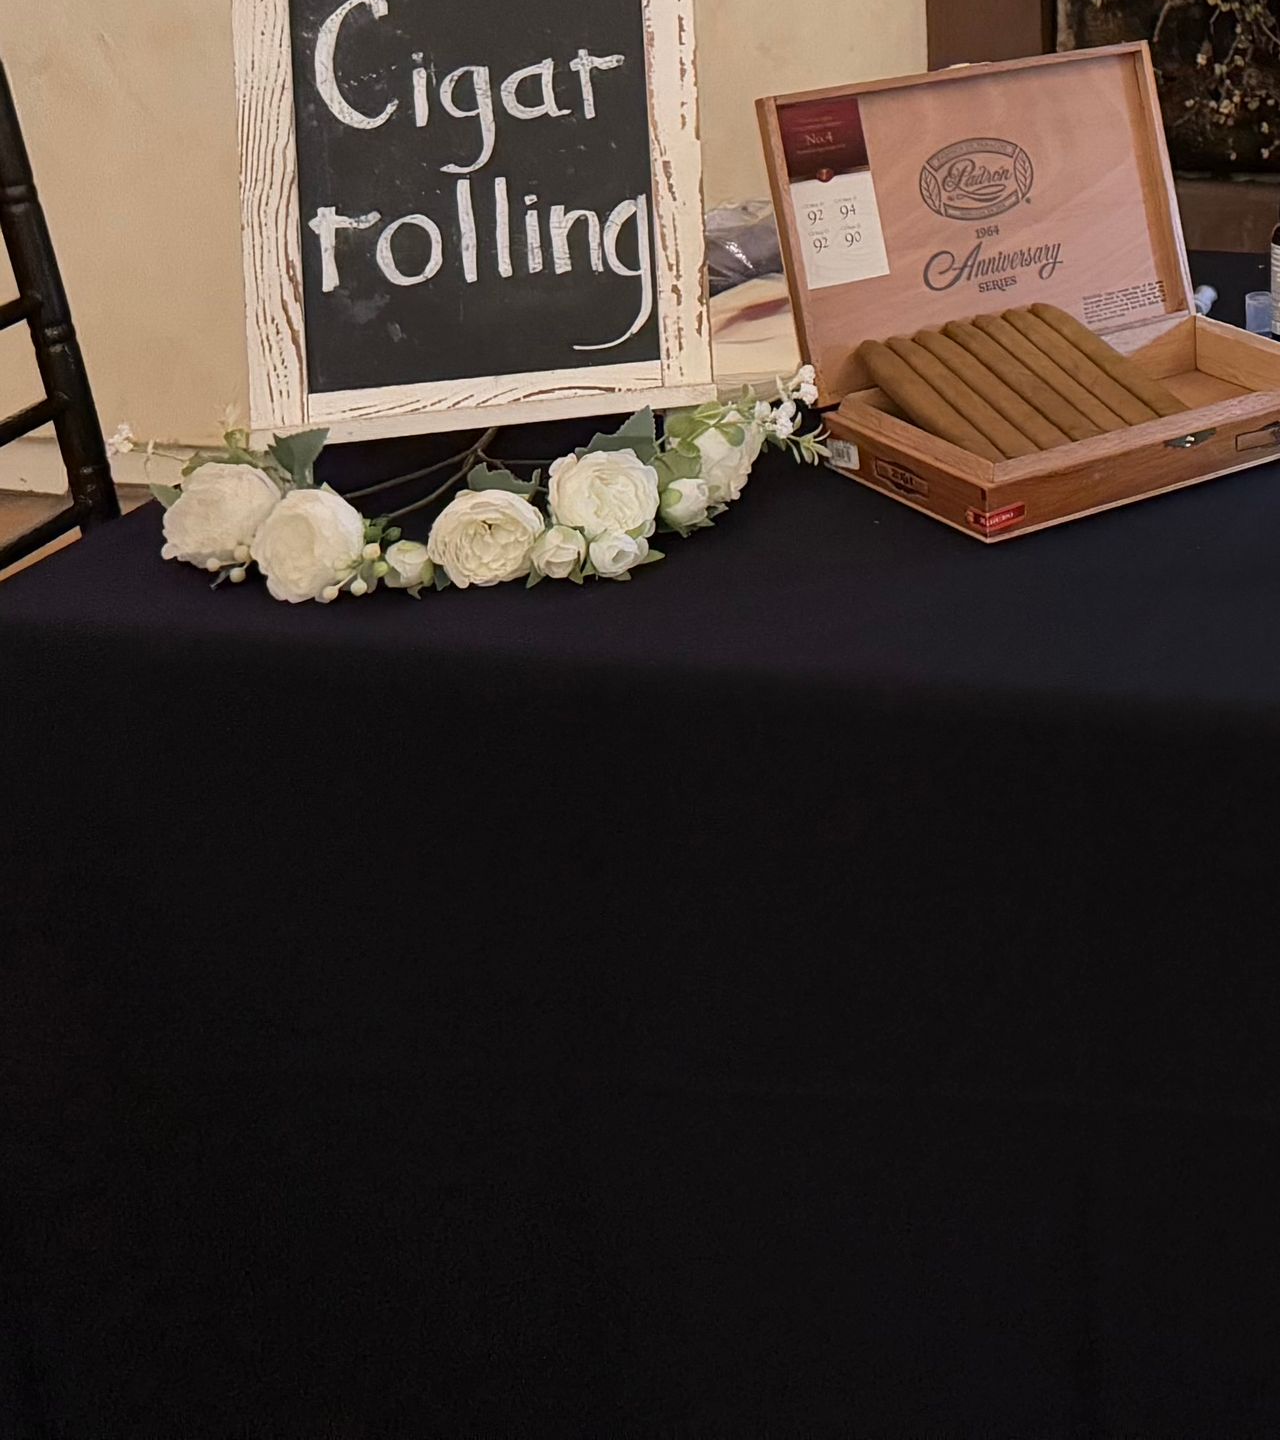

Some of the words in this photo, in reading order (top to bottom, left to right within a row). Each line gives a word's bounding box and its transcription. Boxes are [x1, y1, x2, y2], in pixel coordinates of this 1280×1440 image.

[807, 209, 824, 226] 92
[839, 203, 856, 220] 94
[813, 236, 829, 253] 92
[844, 231, 862, 248] 90
[975, 225, 1000, 239] 1964
[308, 177, 652, 350] rolling
[923, 241, 1064, 291] Anniversary
[978, 276, 1018, 293] SERIES
